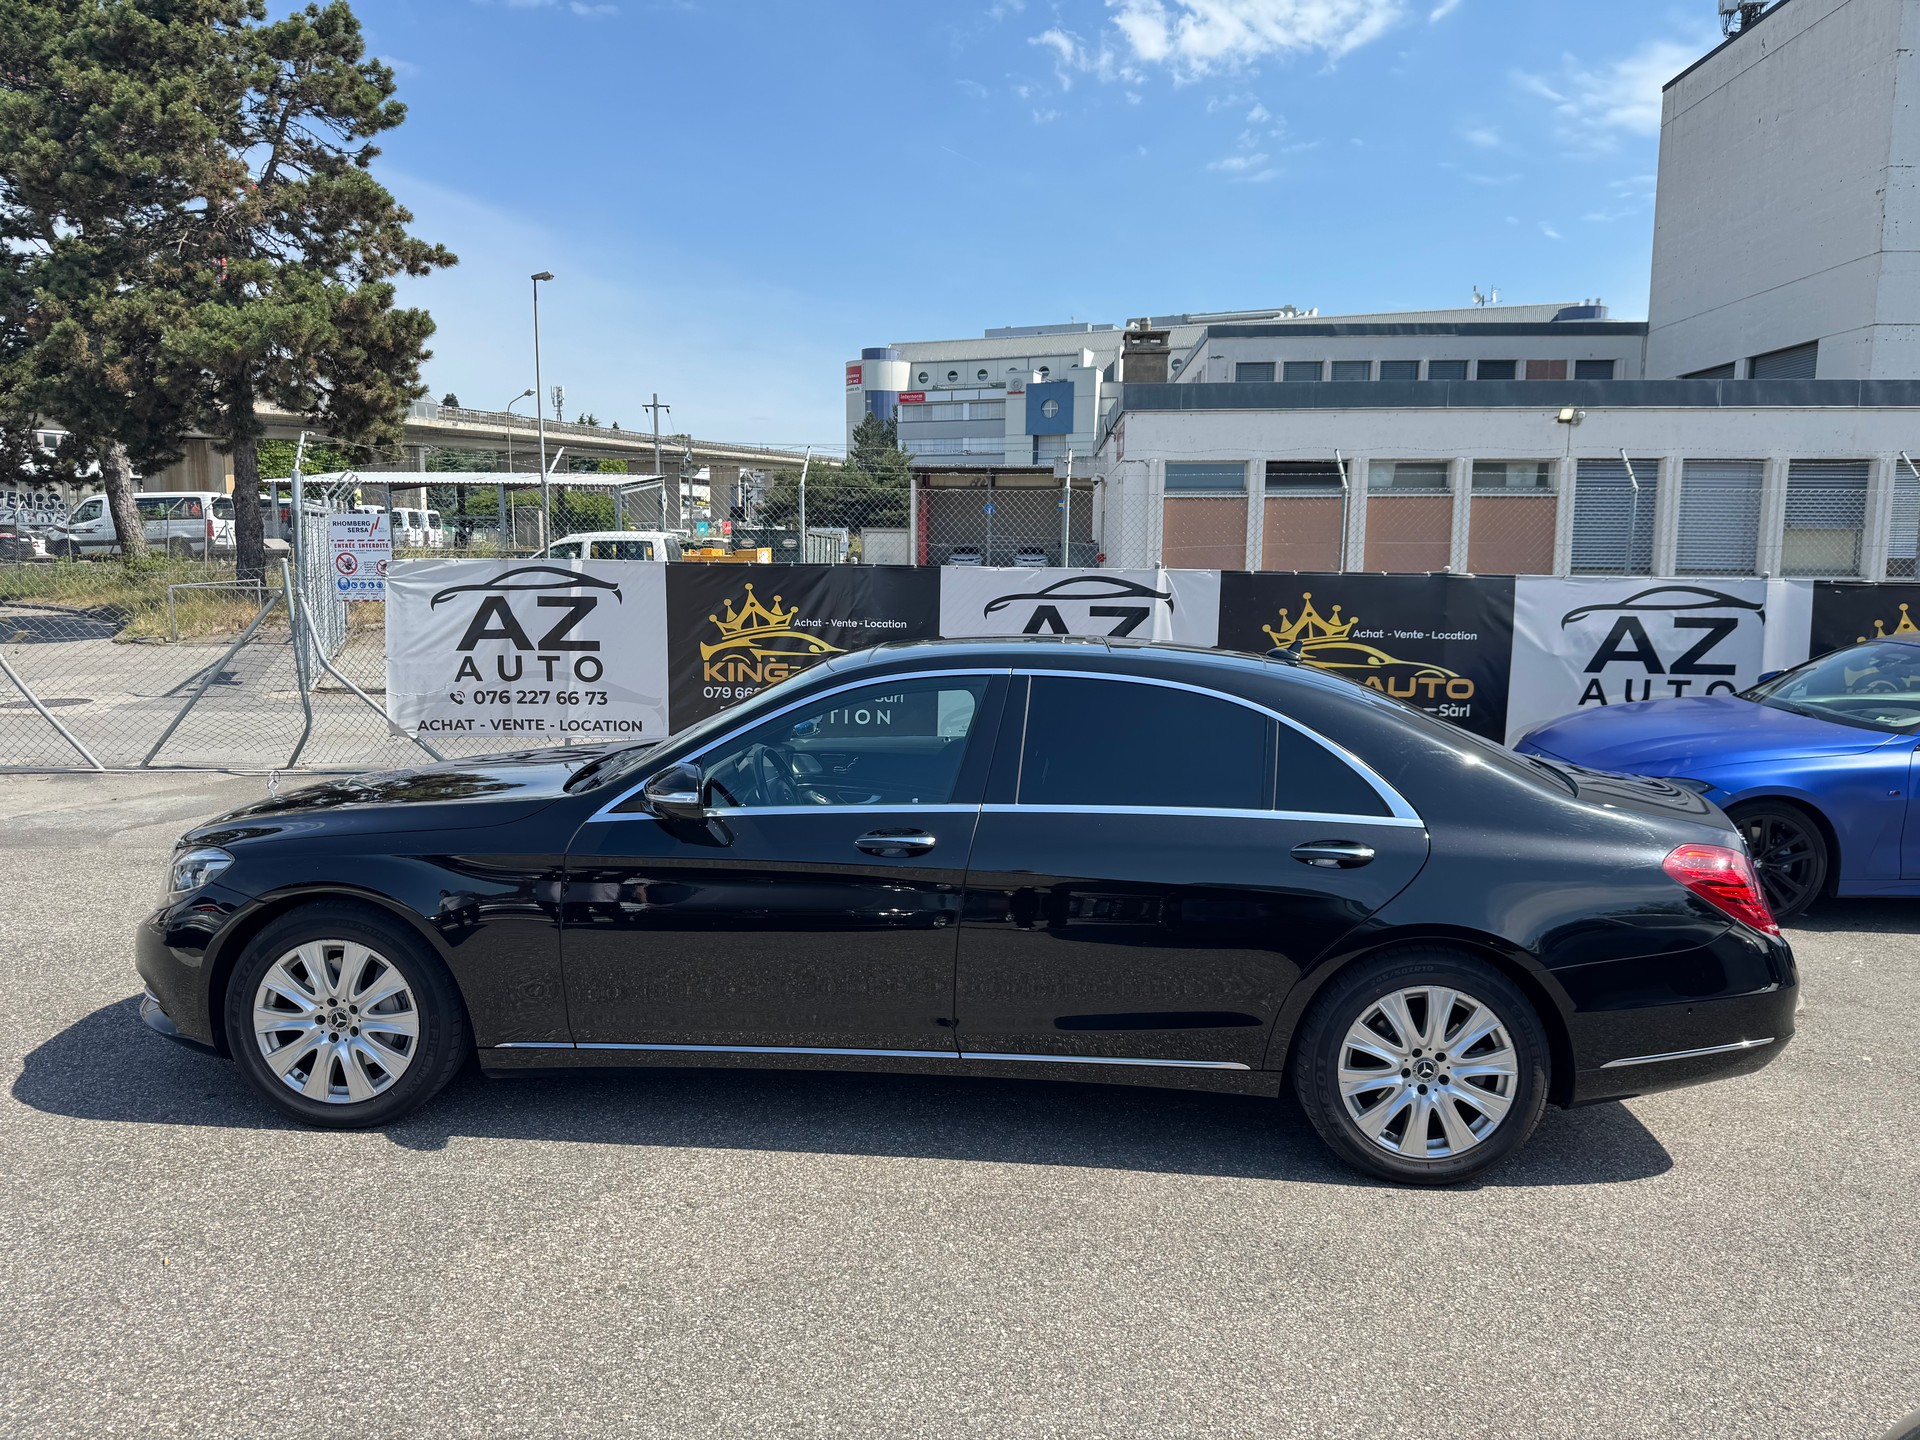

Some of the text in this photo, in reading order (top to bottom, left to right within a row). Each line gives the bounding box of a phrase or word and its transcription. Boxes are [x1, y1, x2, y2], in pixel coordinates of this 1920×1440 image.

[456, 596, 600, 651] AZ
[794, 618, 822, 627] Achat
[831, 619, 857, 628] Vente
[864, 619, 907, 628] Location
[1352, 629, 1384, 639] Achat
[1393, 630, 1424, 640] Vente
[1431, 630, 1477, 641] Location
[1583, 616, 1738, 675] AZ
[455, 655, 603, 682] AUTO
[703, 662, 789, 682] KING
[703, 686, 732, 699] 079
[1364, 676, 1475, 699] AUTO
[1578, 678, 1737, 706] AUTO
[474, 690, 608, 705] 076 227 66 73
[1438, 703, 1471, 717] Sàrl
[417, 719, 475, 731] ACHAT
[490, 720, 545, 731] VENTE
[559, 720, 643, 732] LOCATION
